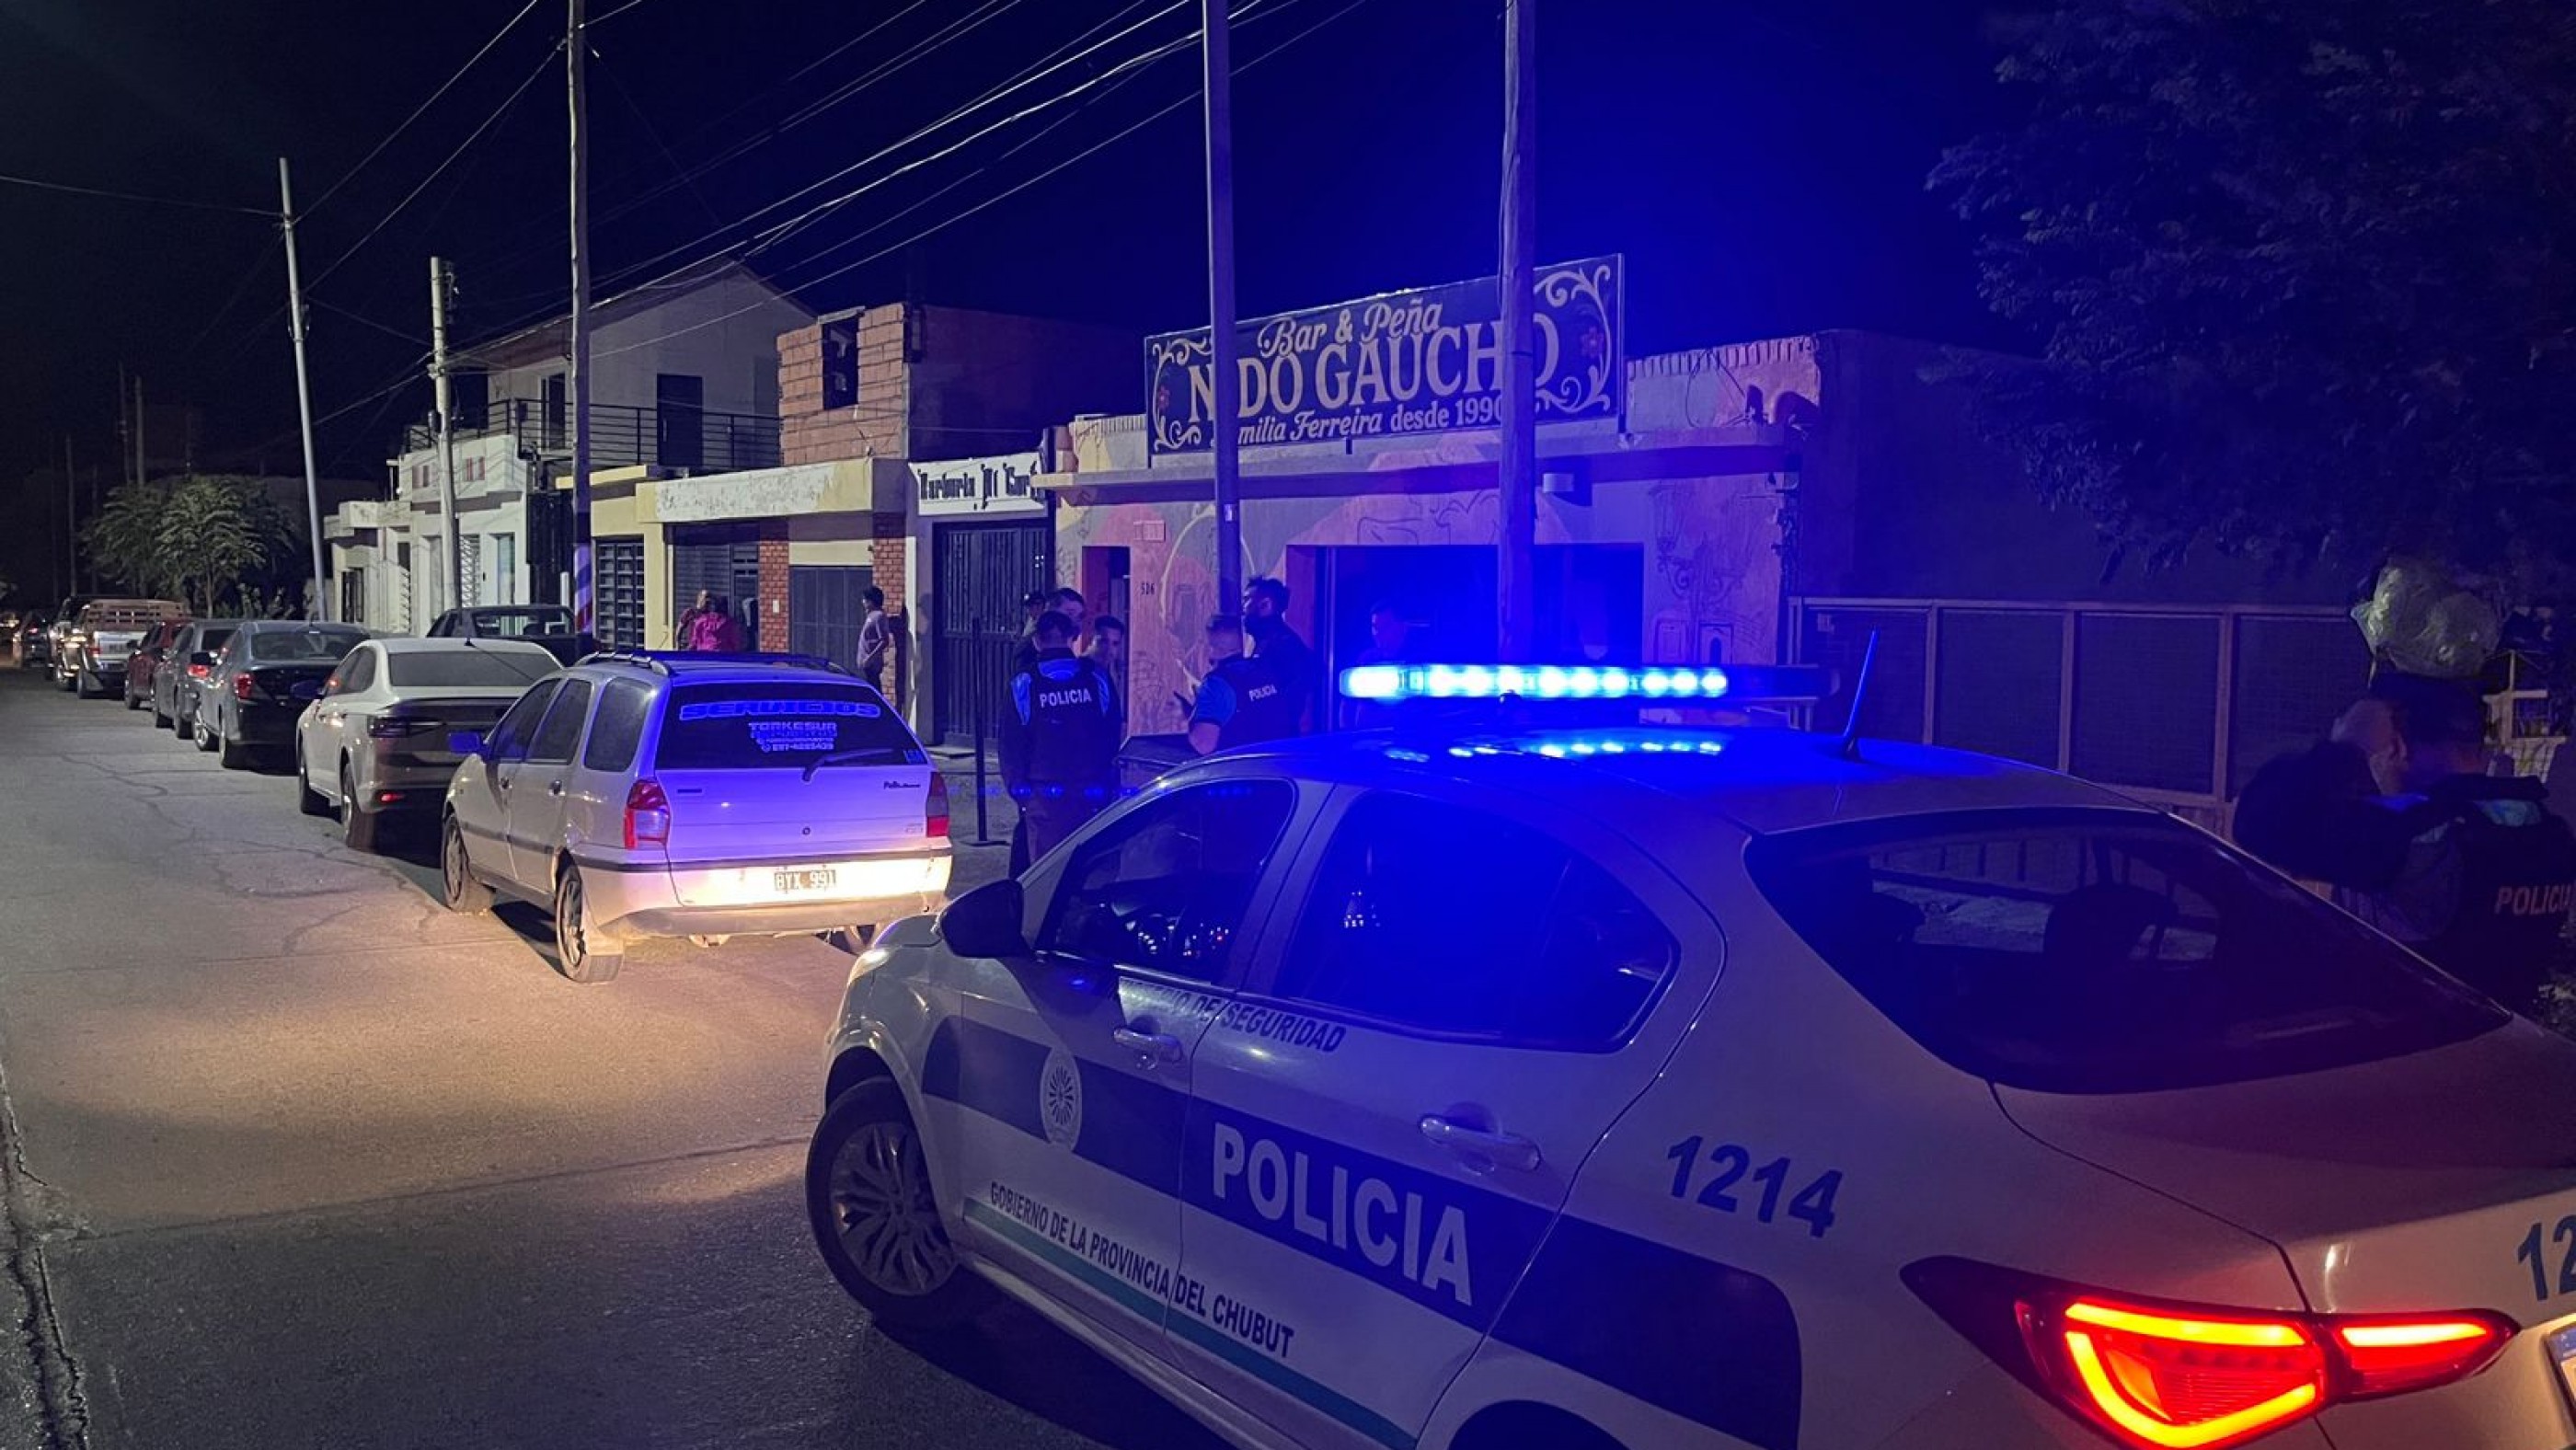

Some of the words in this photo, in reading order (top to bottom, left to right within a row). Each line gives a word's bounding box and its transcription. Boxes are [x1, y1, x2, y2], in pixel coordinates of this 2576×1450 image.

[1258, 316, 1327, 358] Bar
[1334, 308, 1353, 344] &
[1363, 297, 1443, 340] Peña
[1188, 355, 1304, 423] NDO
[1290, 410, 1382, 441] Ferreira
[1390, 399, 1450, 431] desde
[1039, 689, 1092, 708] POLICIA
[1248, 685, 1278, 702] POLICIA
[1221, 1003, 1346, 1053] SEGURIDAD
[1213, 1122, 1472, 1307] POLICIA
[1667, 1135, 1843, 1237] 1214
[990, 1181, 1048, 1232] GOBIERNO
[1049, 1210, 1069, 1238] DE
[1070, 1220, 1087, 1254] LA
[1090, 1228, 1170, 1299] PROVINCIA
[1174, 1274, 1206, 1317] DEL
[1213, 1298, 1295, 1358] CHUBUT
